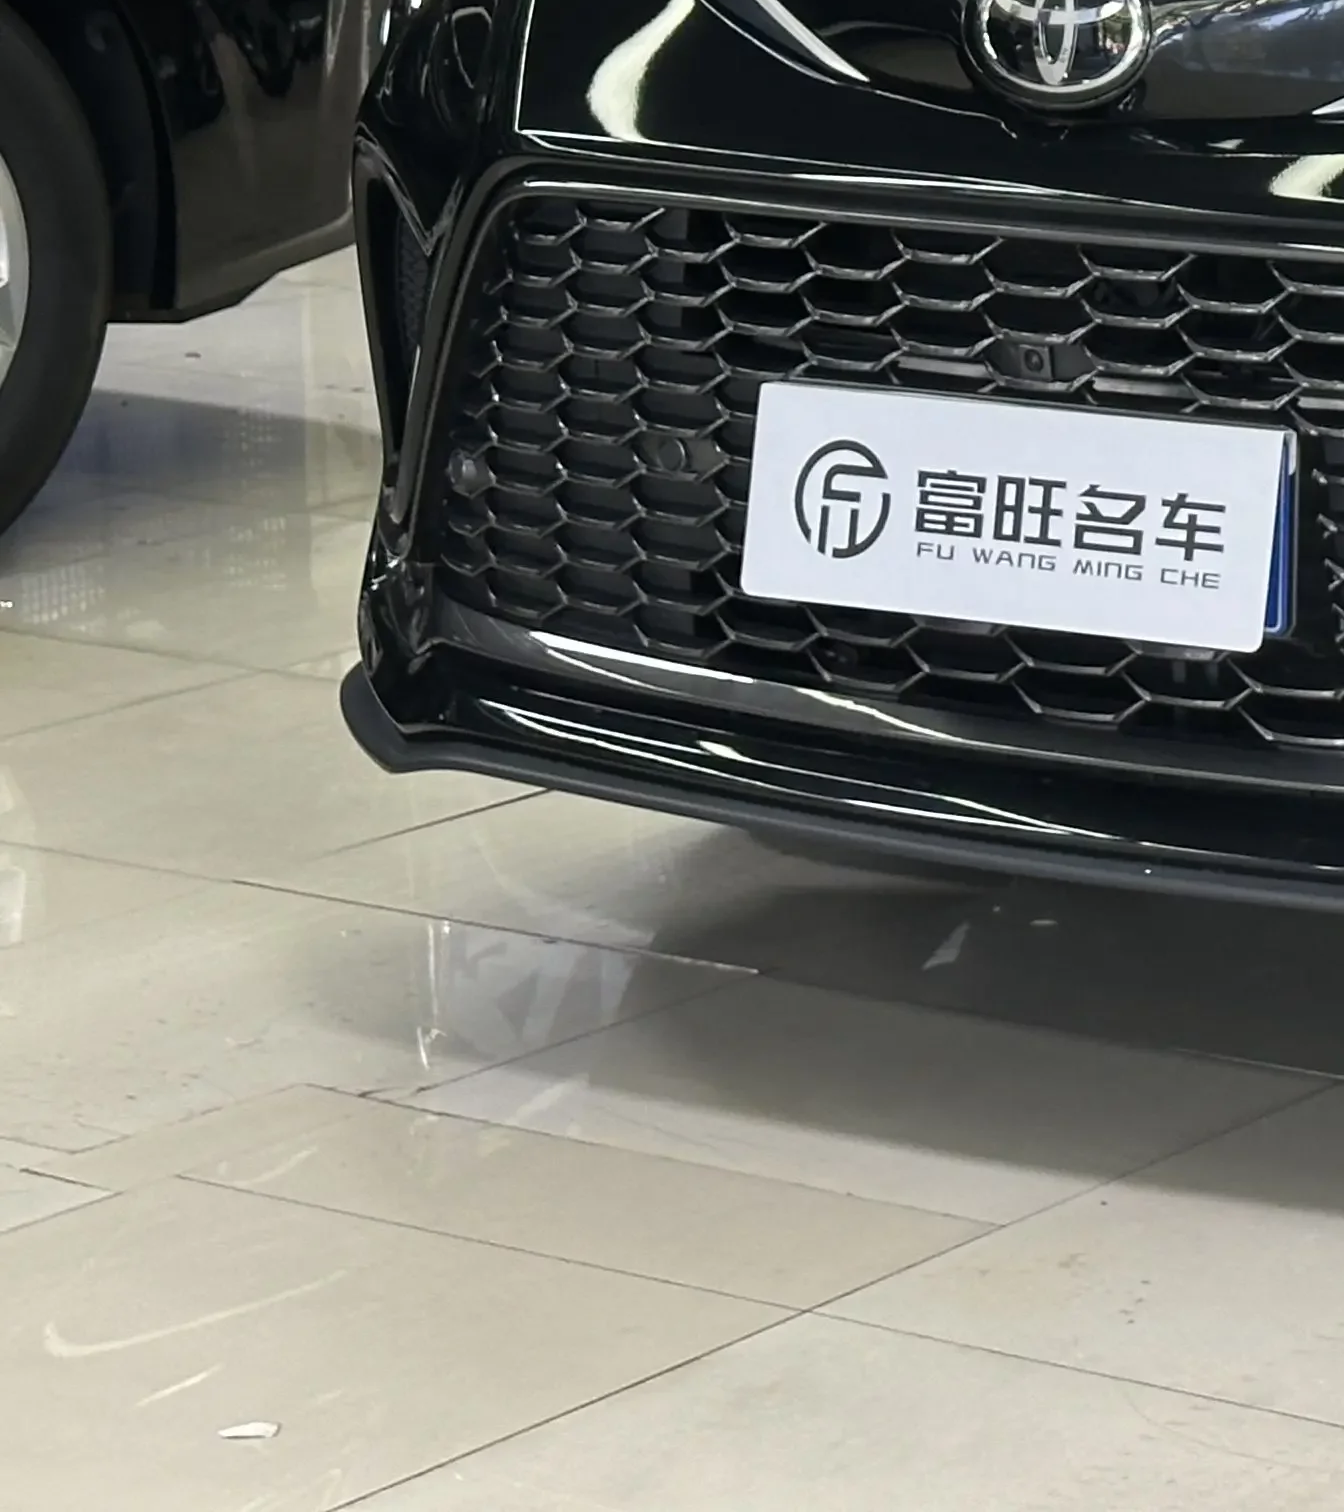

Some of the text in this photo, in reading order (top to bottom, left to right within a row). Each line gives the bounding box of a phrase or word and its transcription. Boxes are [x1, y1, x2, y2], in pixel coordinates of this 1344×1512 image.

[915, 469, 1226, 561] 富旺名车
[916, 542, 1221, 589] FU WANG MING CHE
